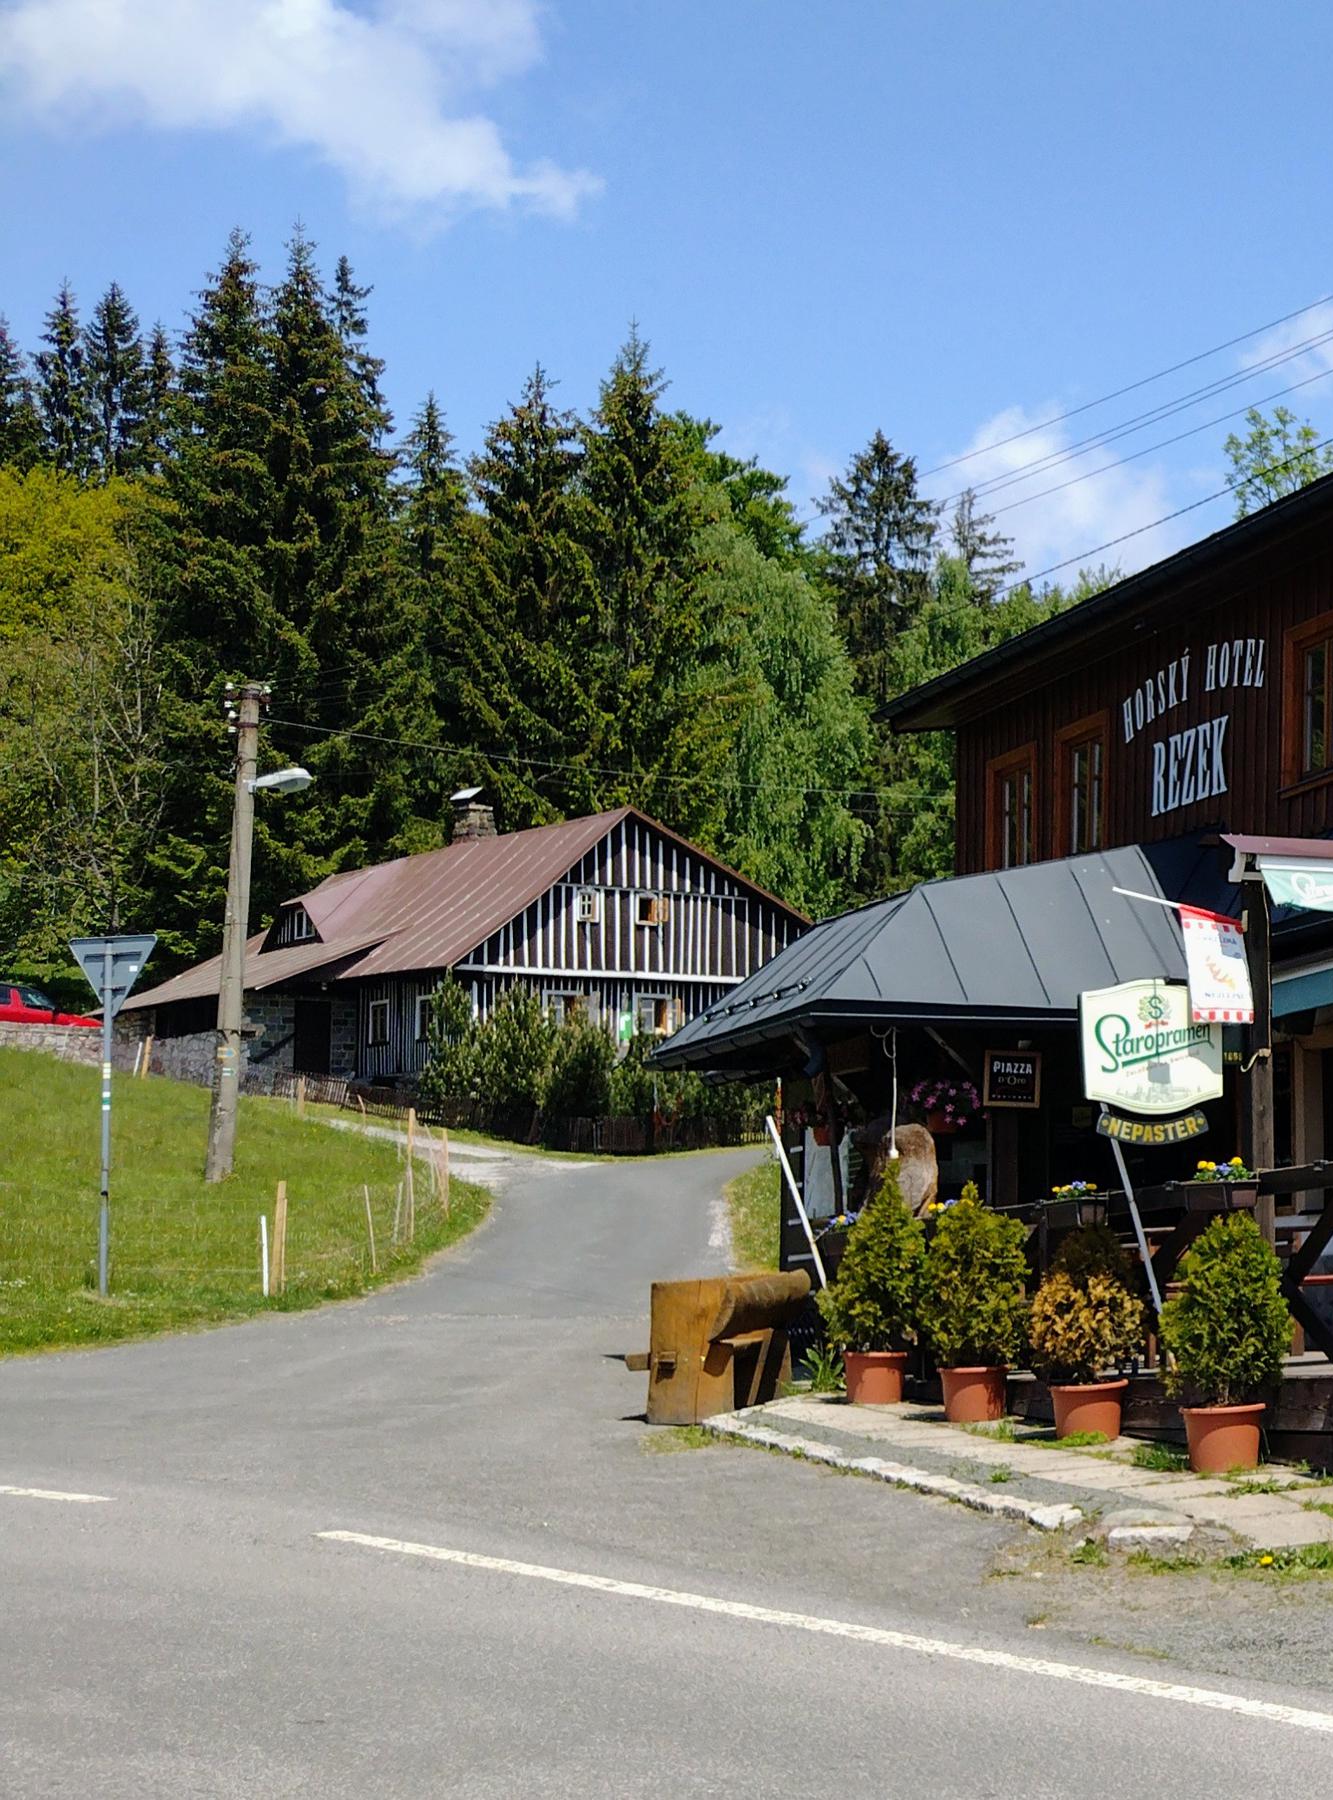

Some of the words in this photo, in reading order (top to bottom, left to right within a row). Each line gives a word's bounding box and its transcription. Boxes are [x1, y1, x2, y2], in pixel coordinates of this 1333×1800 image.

[1123, 647, 1190, 743] HORSKÝ
[1205, 639, 1265, 692] HOTEL
[1151, 715, 1229, 817] REZEK
[993, 1061, 1032, 1074] PIAZZA
[1094, 1014, 1212, 1073] Staropramen
[1107, 1116, 1200, 1142] NEPASTER
